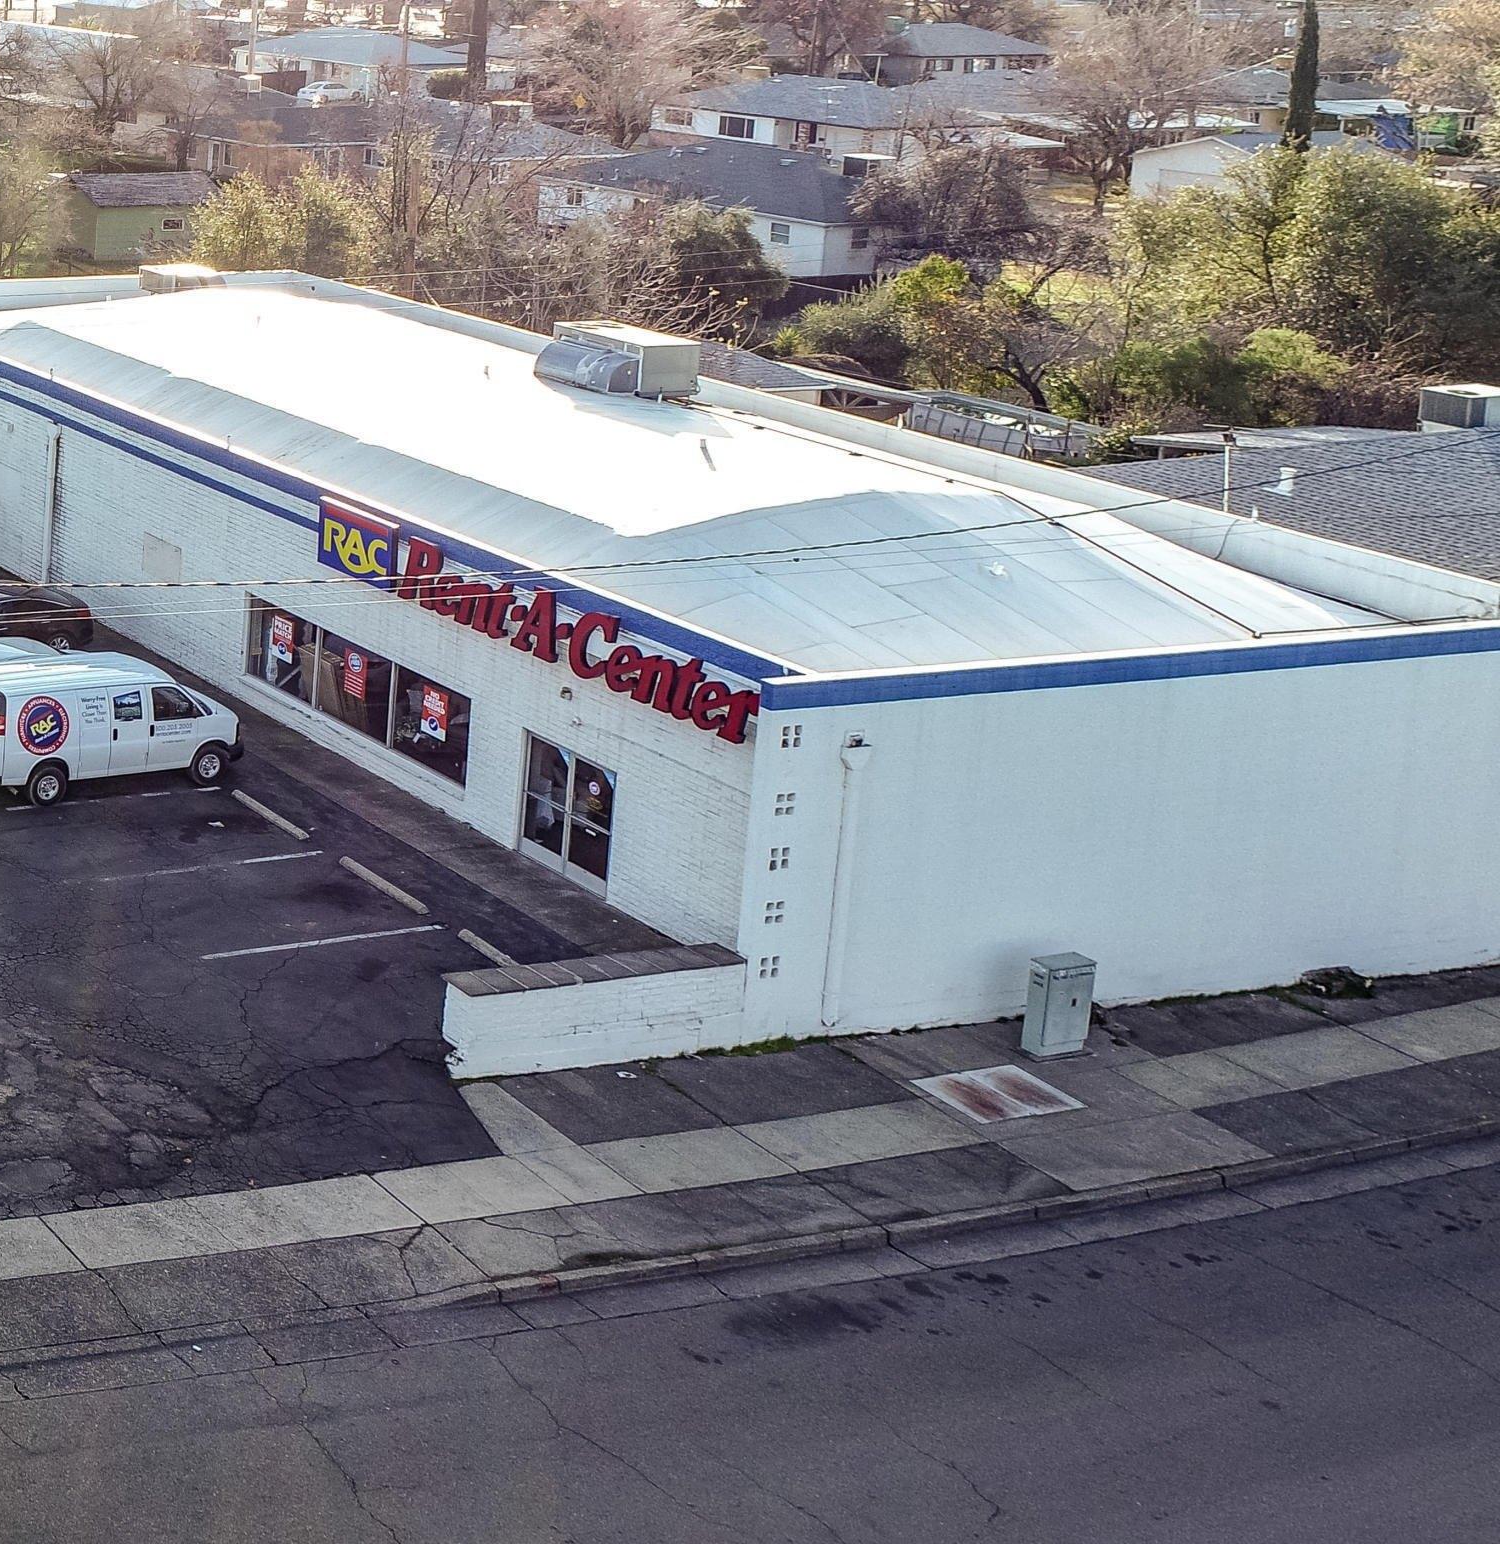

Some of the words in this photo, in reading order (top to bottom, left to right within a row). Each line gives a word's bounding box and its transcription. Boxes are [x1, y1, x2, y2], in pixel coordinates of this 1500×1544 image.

[322, 516, 389, 577] RAC
[275, 619, 292, 634] PRICE
[30, 713, 57, 737] RAC
